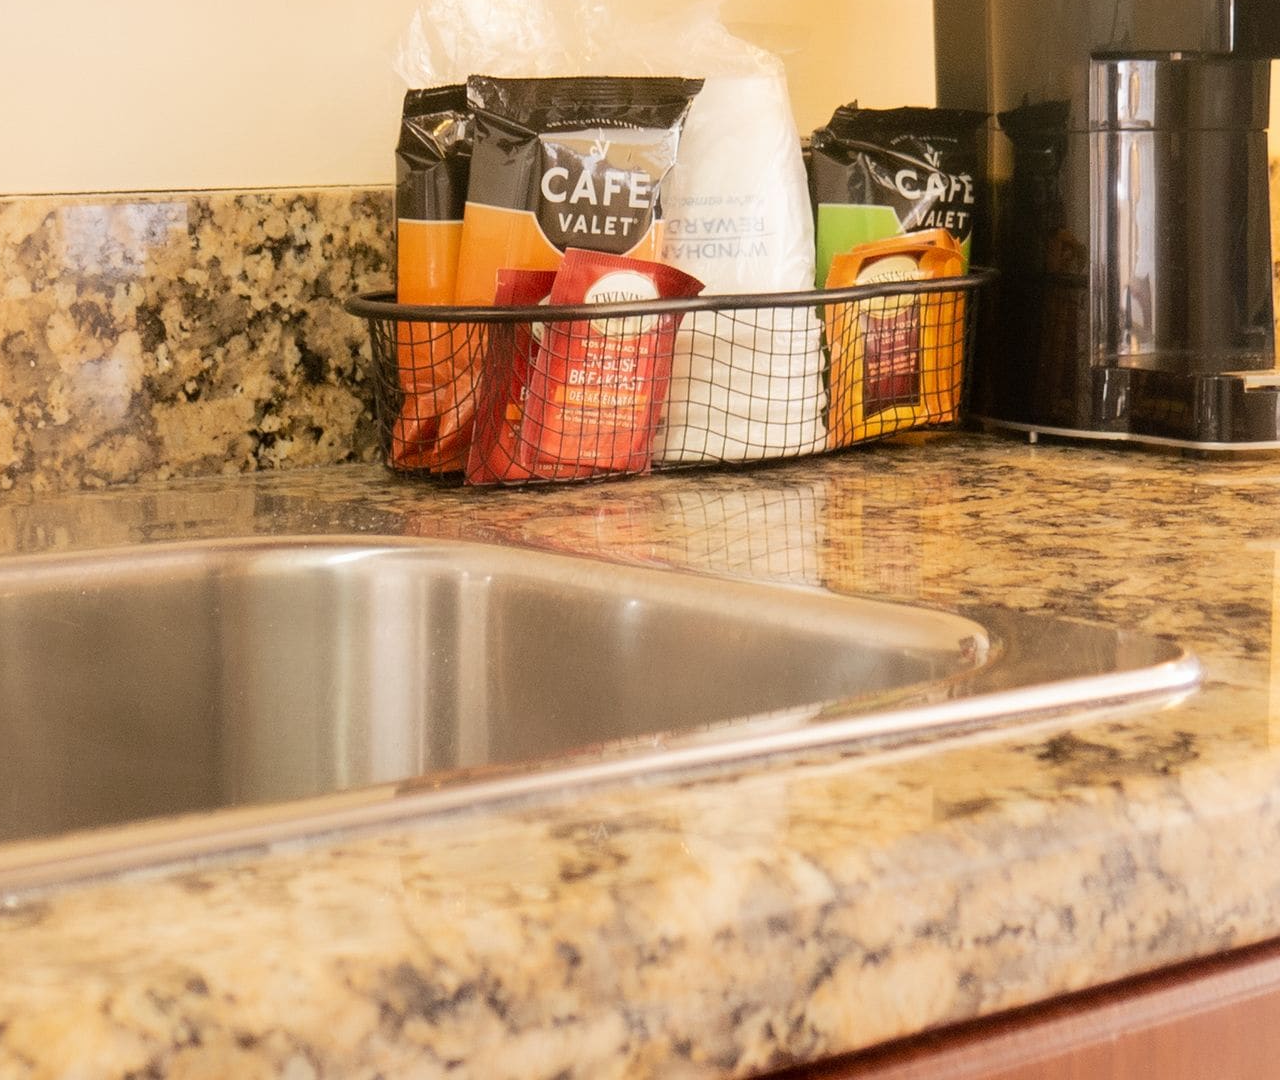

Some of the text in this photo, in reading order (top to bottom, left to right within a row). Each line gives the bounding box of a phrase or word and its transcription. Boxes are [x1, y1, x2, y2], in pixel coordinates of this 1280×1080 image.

[558, 213, 634, 237] VALET
[915, 210, 968, 229] VALET
[568, 369, 645, 392] BREAKFAST
